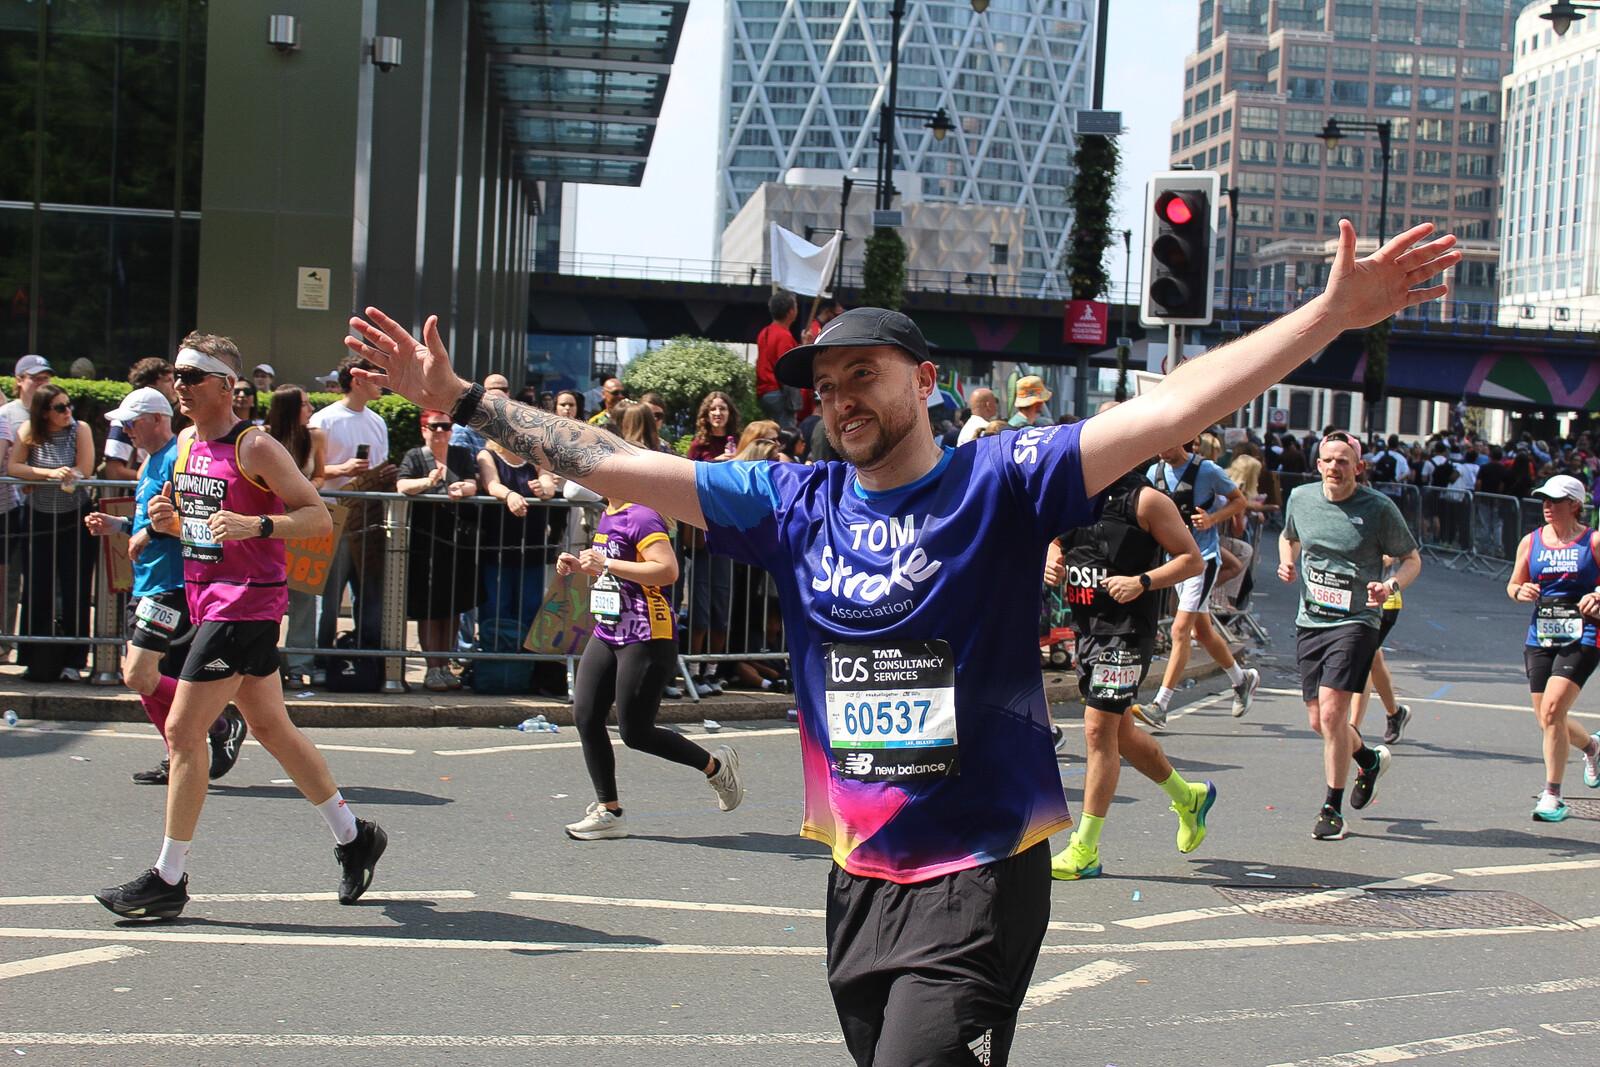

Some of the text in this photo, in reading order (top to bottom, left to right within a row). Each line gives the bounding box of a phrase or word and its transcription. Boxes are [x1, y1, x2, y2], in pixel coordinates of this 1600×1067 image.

[190, 455, 211, 475] LEE
[849, 514, 915, 552] TOM
[1537, 549, 1579, 561] JAMIE
[812, 544, 942, 601] Stroke
[1068, 587, 1094, 605] BHF
[1312, 589, 1342, 605] 15663
[831, 599, 914, 619] Association
[872, 649, 902, 659] TATA
[831, 649, 869, 682] tcs
[873, 658, 944, 671] CONSULTANCY
[874, 670, 918, 682] SERVICES
[844, 700, 932, 735] 60537
[875, 762, 946, 776] new balance
